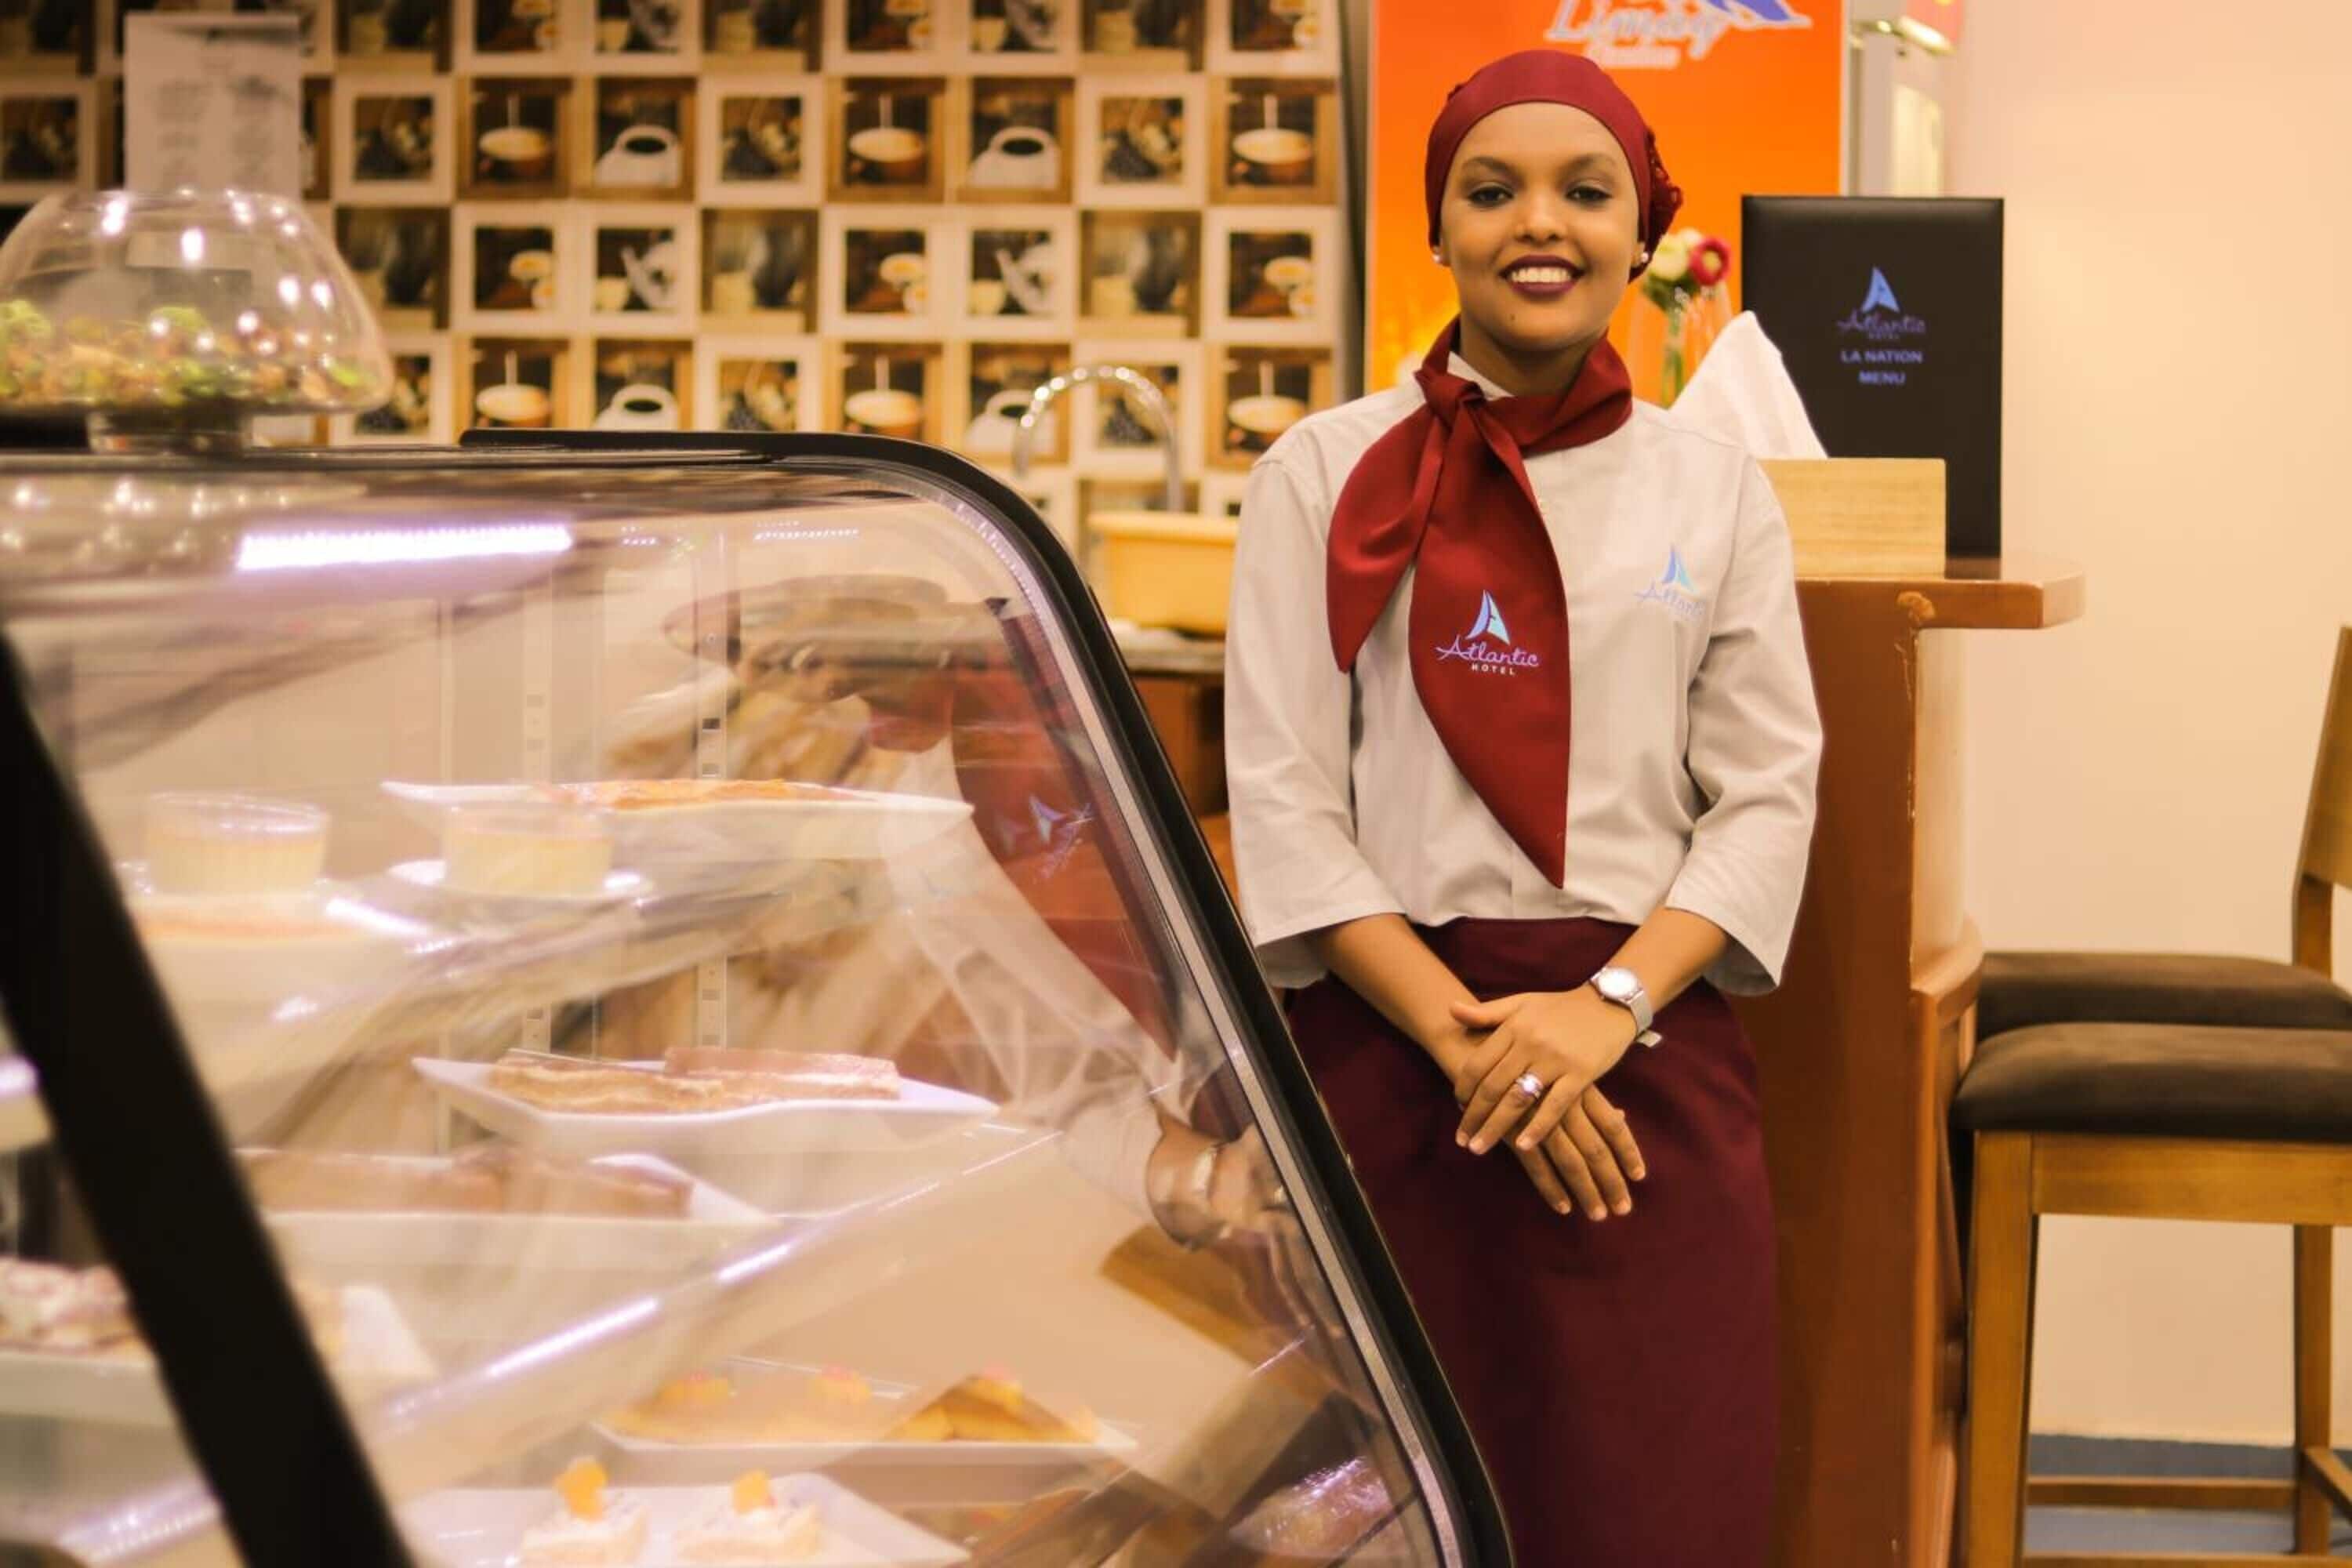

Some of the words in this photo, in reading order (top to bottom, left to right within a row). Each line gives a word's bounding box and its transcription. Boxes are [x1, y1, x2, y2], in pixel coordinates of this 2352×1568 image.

[1842, 350, 1862, 363] LA
[1864, 350, 1923, 363] NATION
[1858, 372, 1906, 384] MENU
[1435, 633, 1540, 667] Atlantic
[1471, 662, 1516, 676] HOTEL
